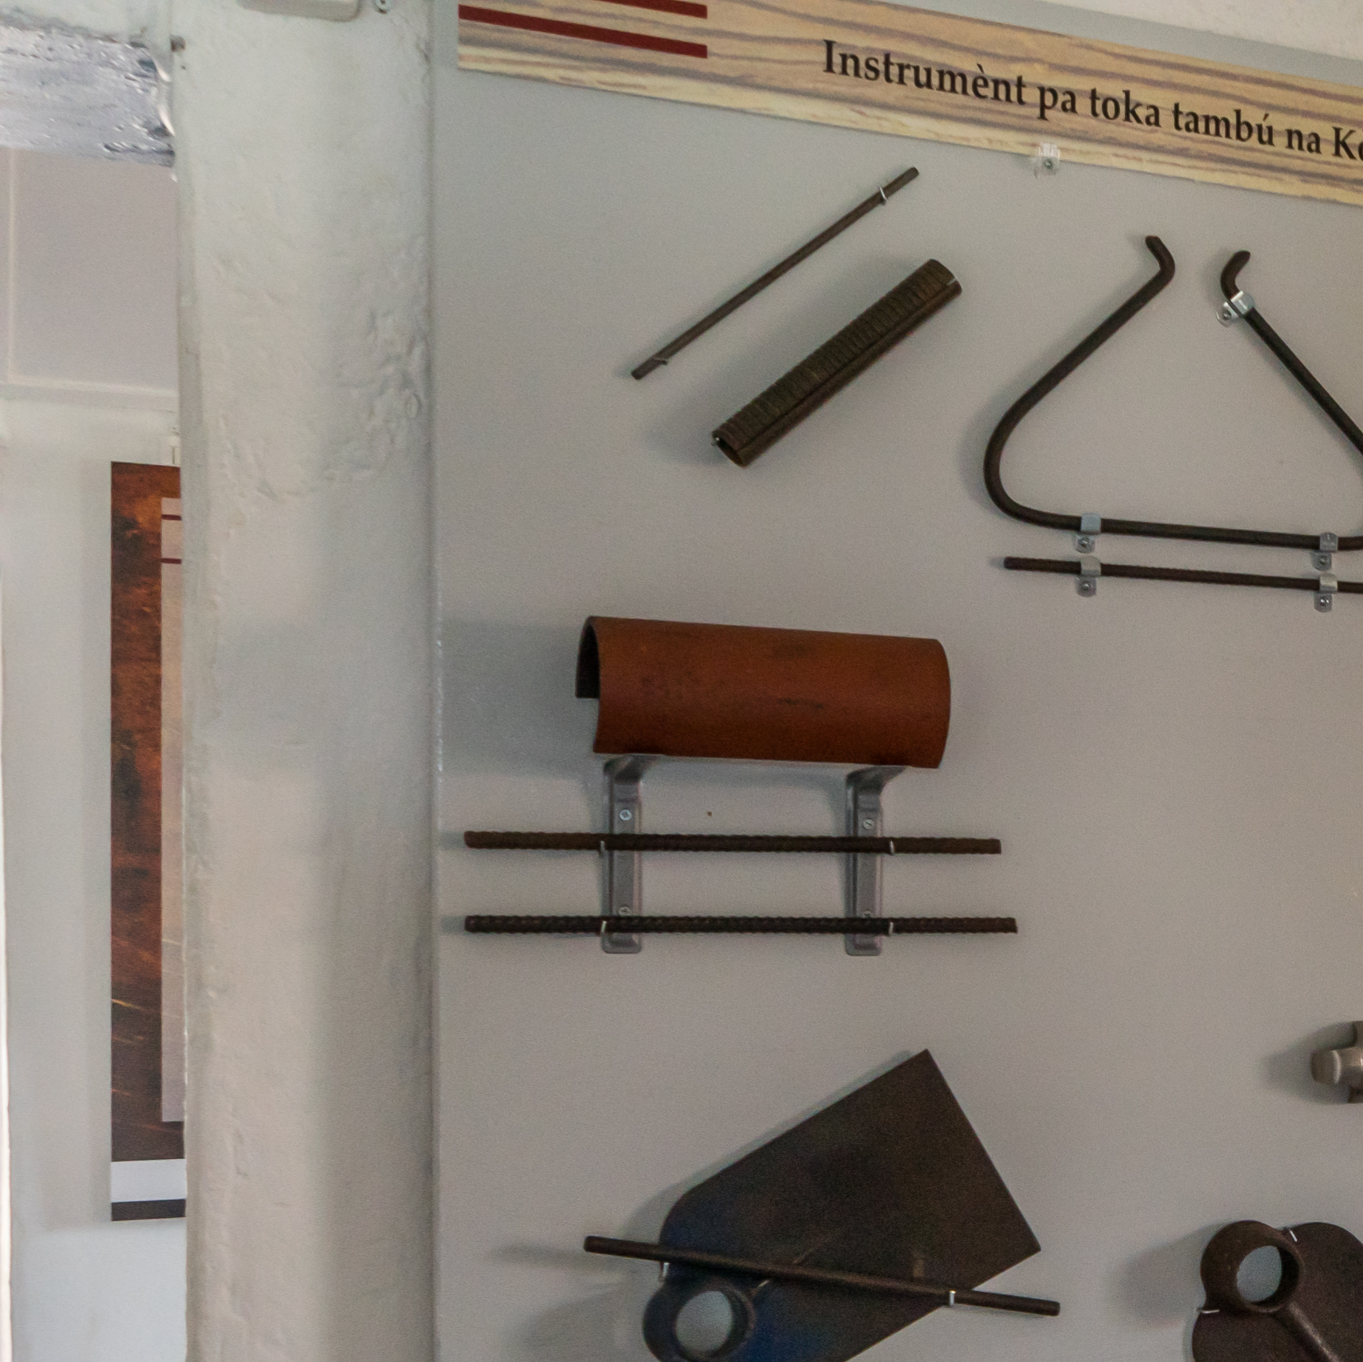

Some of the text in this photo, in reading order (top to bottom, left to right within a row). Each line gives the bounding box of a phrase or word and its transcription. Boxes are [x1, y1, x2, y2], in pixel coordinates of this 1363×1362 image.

[823, 39, 1026, 105] Instrumènt
[1037, 85, 1078, 120] pa
[1090, 88, 1162, 127] toka
[1172, 101, 1275, 147] tambú
[1285, 128, 1322, 155] na
